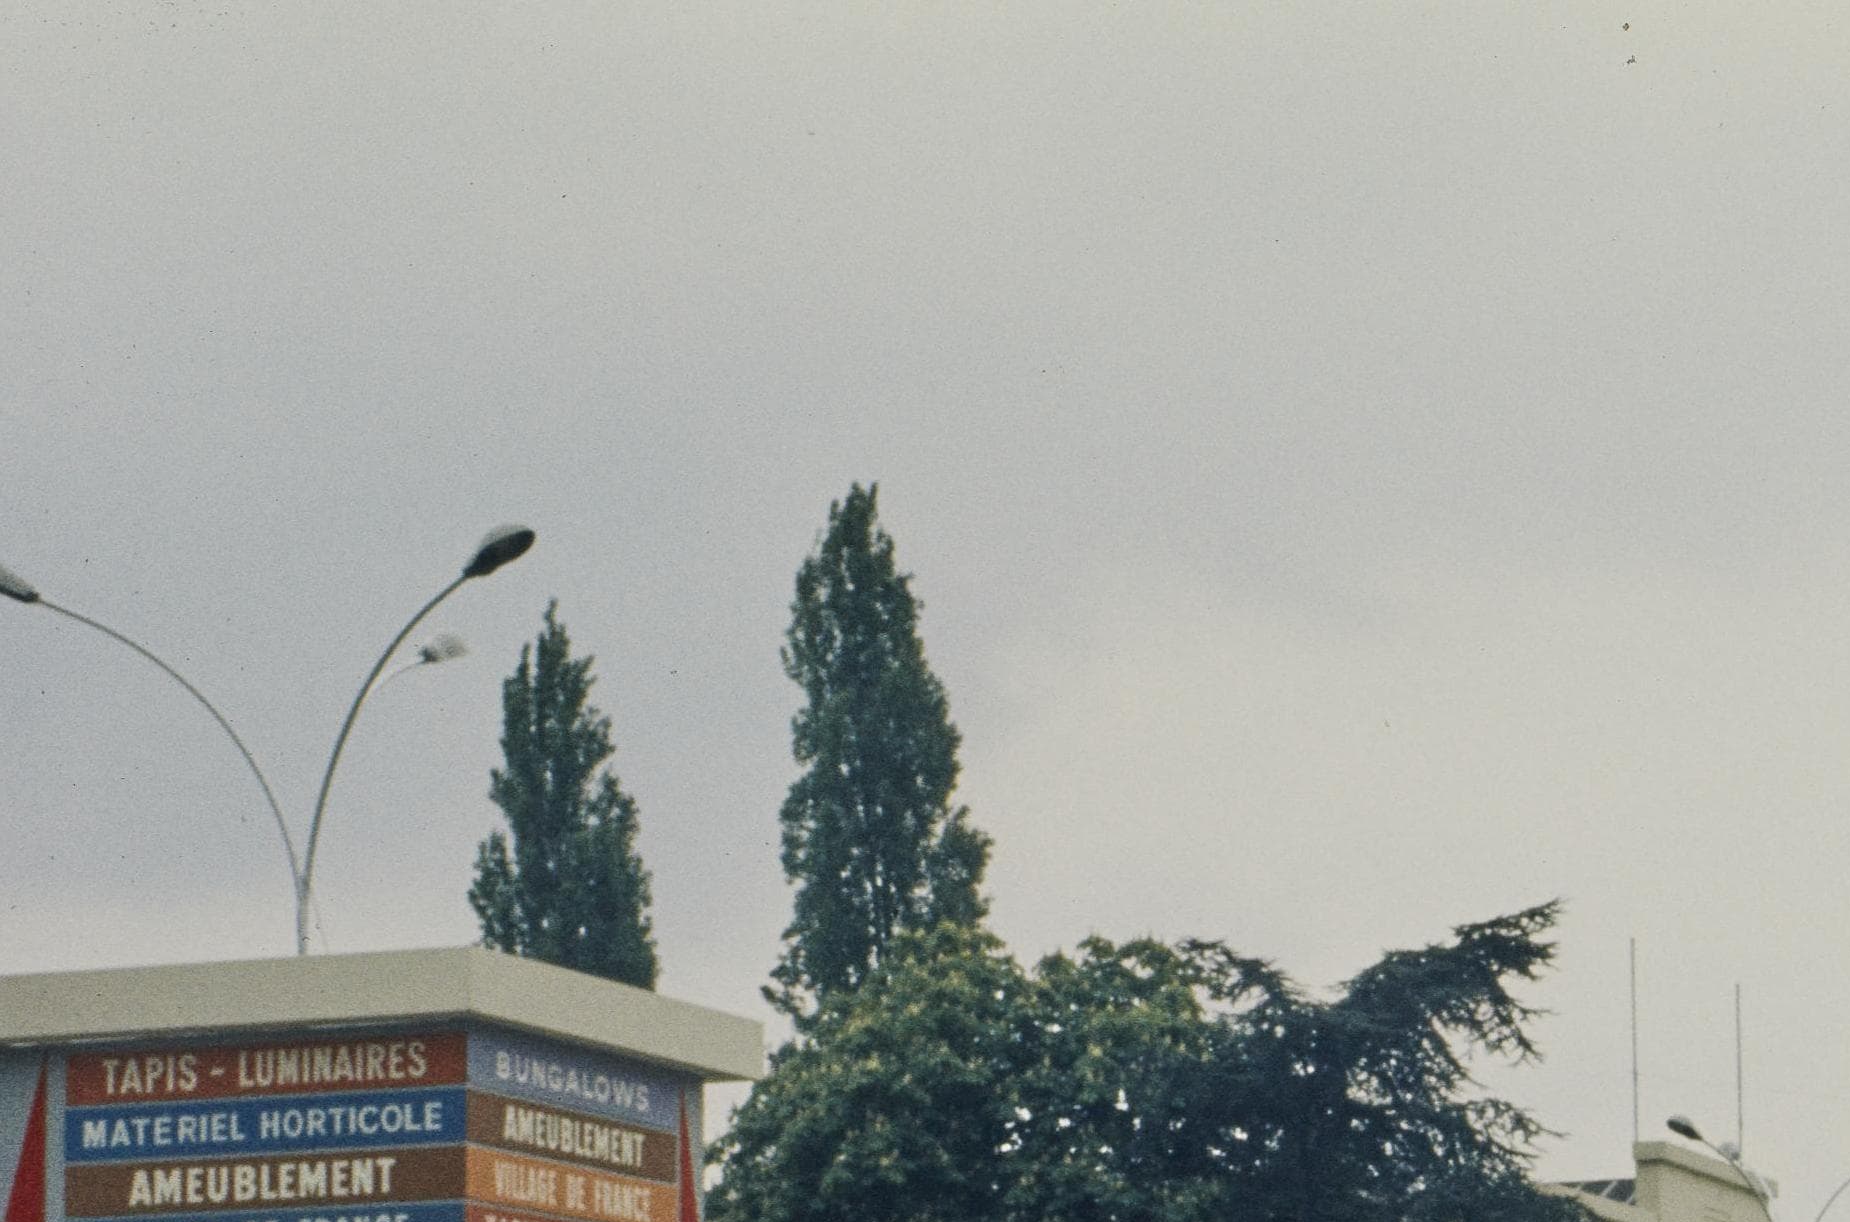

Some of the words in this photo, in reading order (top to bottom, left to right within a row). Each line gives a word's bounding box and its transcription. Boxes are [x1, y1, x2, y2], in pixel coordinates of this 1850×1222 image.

[102, 1054, 197, 1095] TAPIS
[239, 1043, 427, 1088] LUMINAIRES
[496, 1051, 649, 1112] BUNGALOWS
[82, 1112, 246, 1149] MATERIEL
[260, 1102, 443, 1140] HORTICOLE
[503, 1104, 646, 1168] AMEUBLEMENT
[128, 1157, 397, 1207] AMEUBLEMENT
